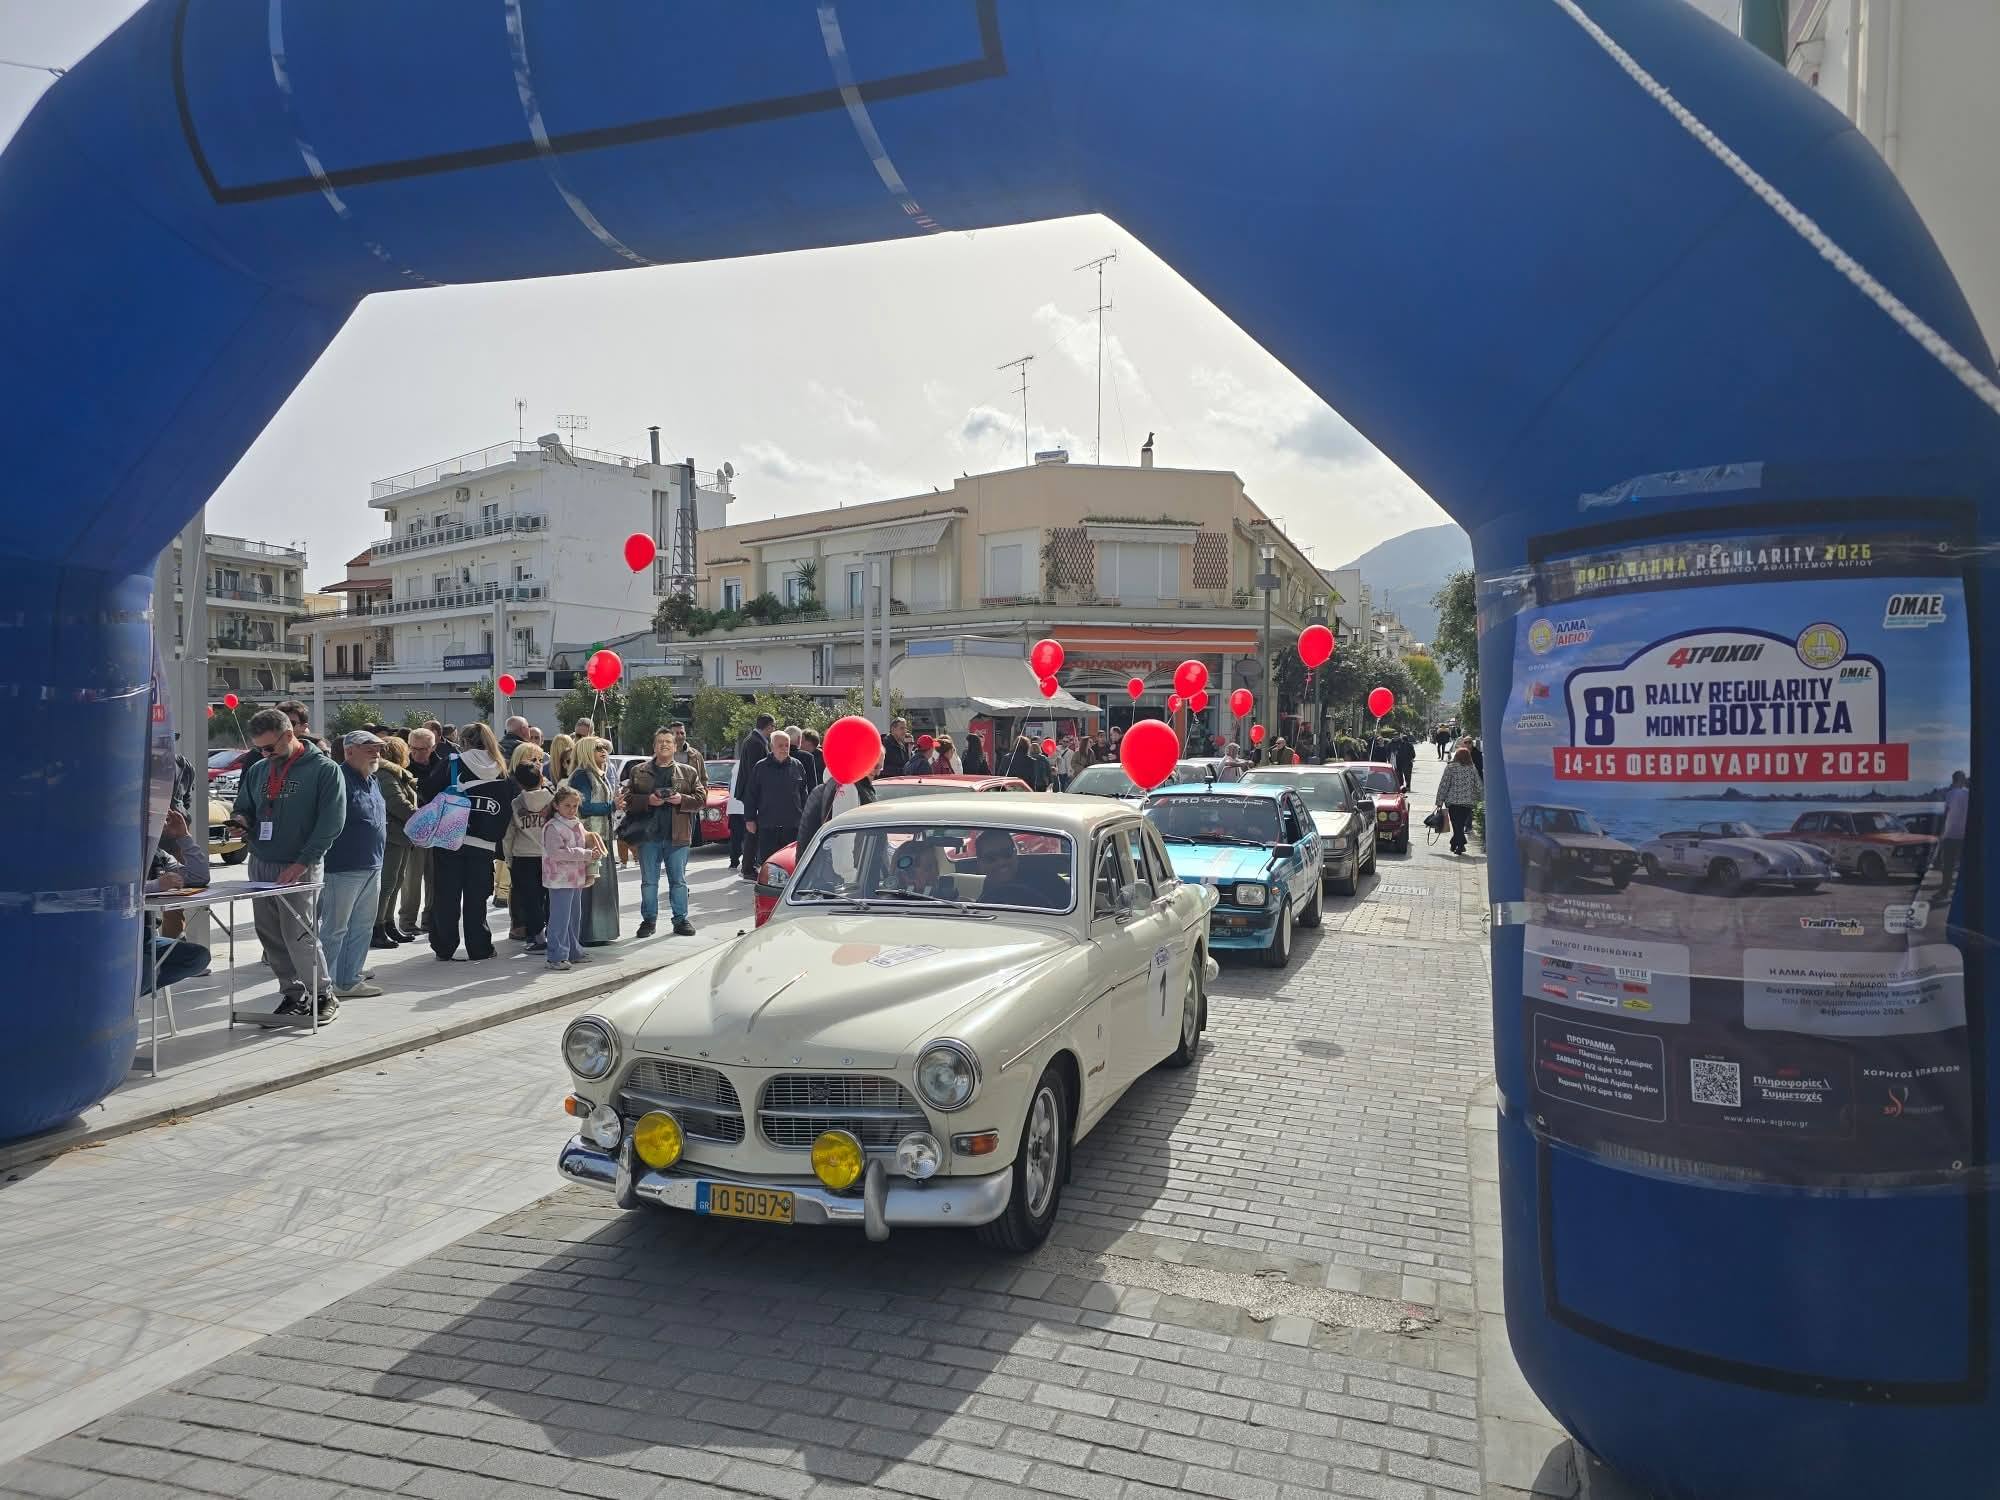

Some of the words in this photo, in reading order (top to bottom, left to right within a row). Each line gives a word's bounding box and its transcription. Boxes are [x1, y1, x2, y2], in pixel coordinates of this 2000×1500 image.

[1696, 547, 1815, 569] REGULARITY
[1824, 544, 1871, 561] 2026
[1557, 620, 1586, 633] ΑΛΜΑ
[1645, 682, 1704, 705] RALLY
[1708, 678, 1833, 703] REGULARITY
[1646, 714, 1707, 737] MONTE
[1708, 700, 1853, 736] ΒΟΣΤΙΤΣΑ
[1562, 753, 1616, 775] 14-15
[1626, 752, 1809, 776] ΦΕΒΡΟΥΑΡΙΟΥ
[1822, 751, 1886, 775] 2026
[1566, 1034, 1616, 1052] ΠΡΟΓΡΑΜΜΑ
[1753, 1075, 1823, 1088] Πληροφορίες
[1762, 1088, 1823, 1102] Συμμετοχές
[699, 1201, 710, 1210] GR
[735, 1190, 778, 1217] 5097
